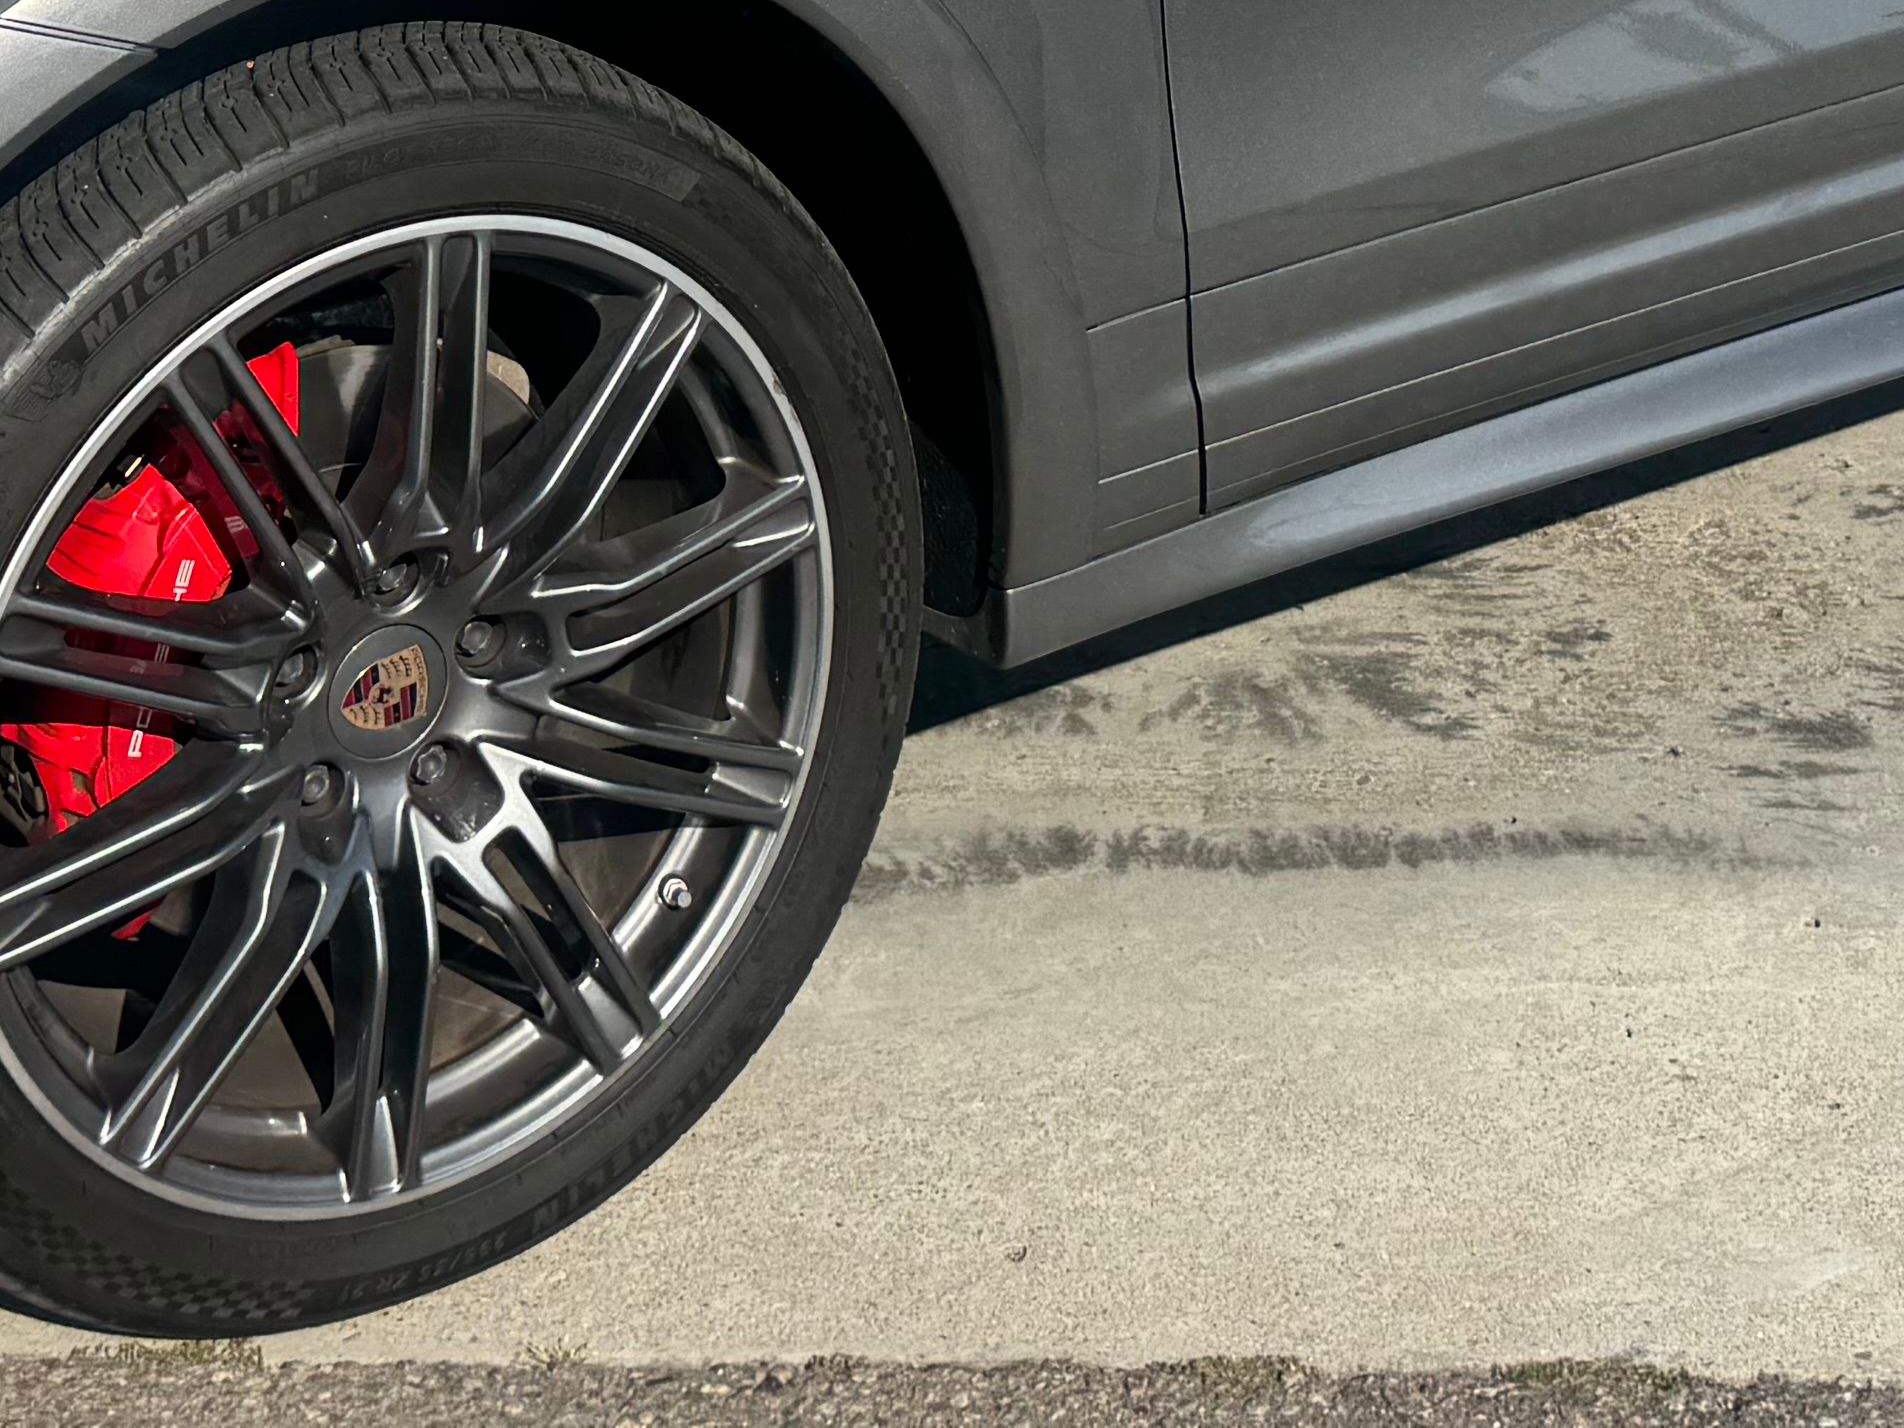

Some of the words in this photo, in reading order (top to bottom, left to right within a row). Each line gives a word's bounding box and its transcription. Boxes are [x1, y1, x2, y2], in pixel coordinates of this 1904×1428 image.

[84, 166, 321, 352] MICHELIN
[127, 559, 196, 758] POSHE
[532, 1041, 737, 1230] MICHELIN
